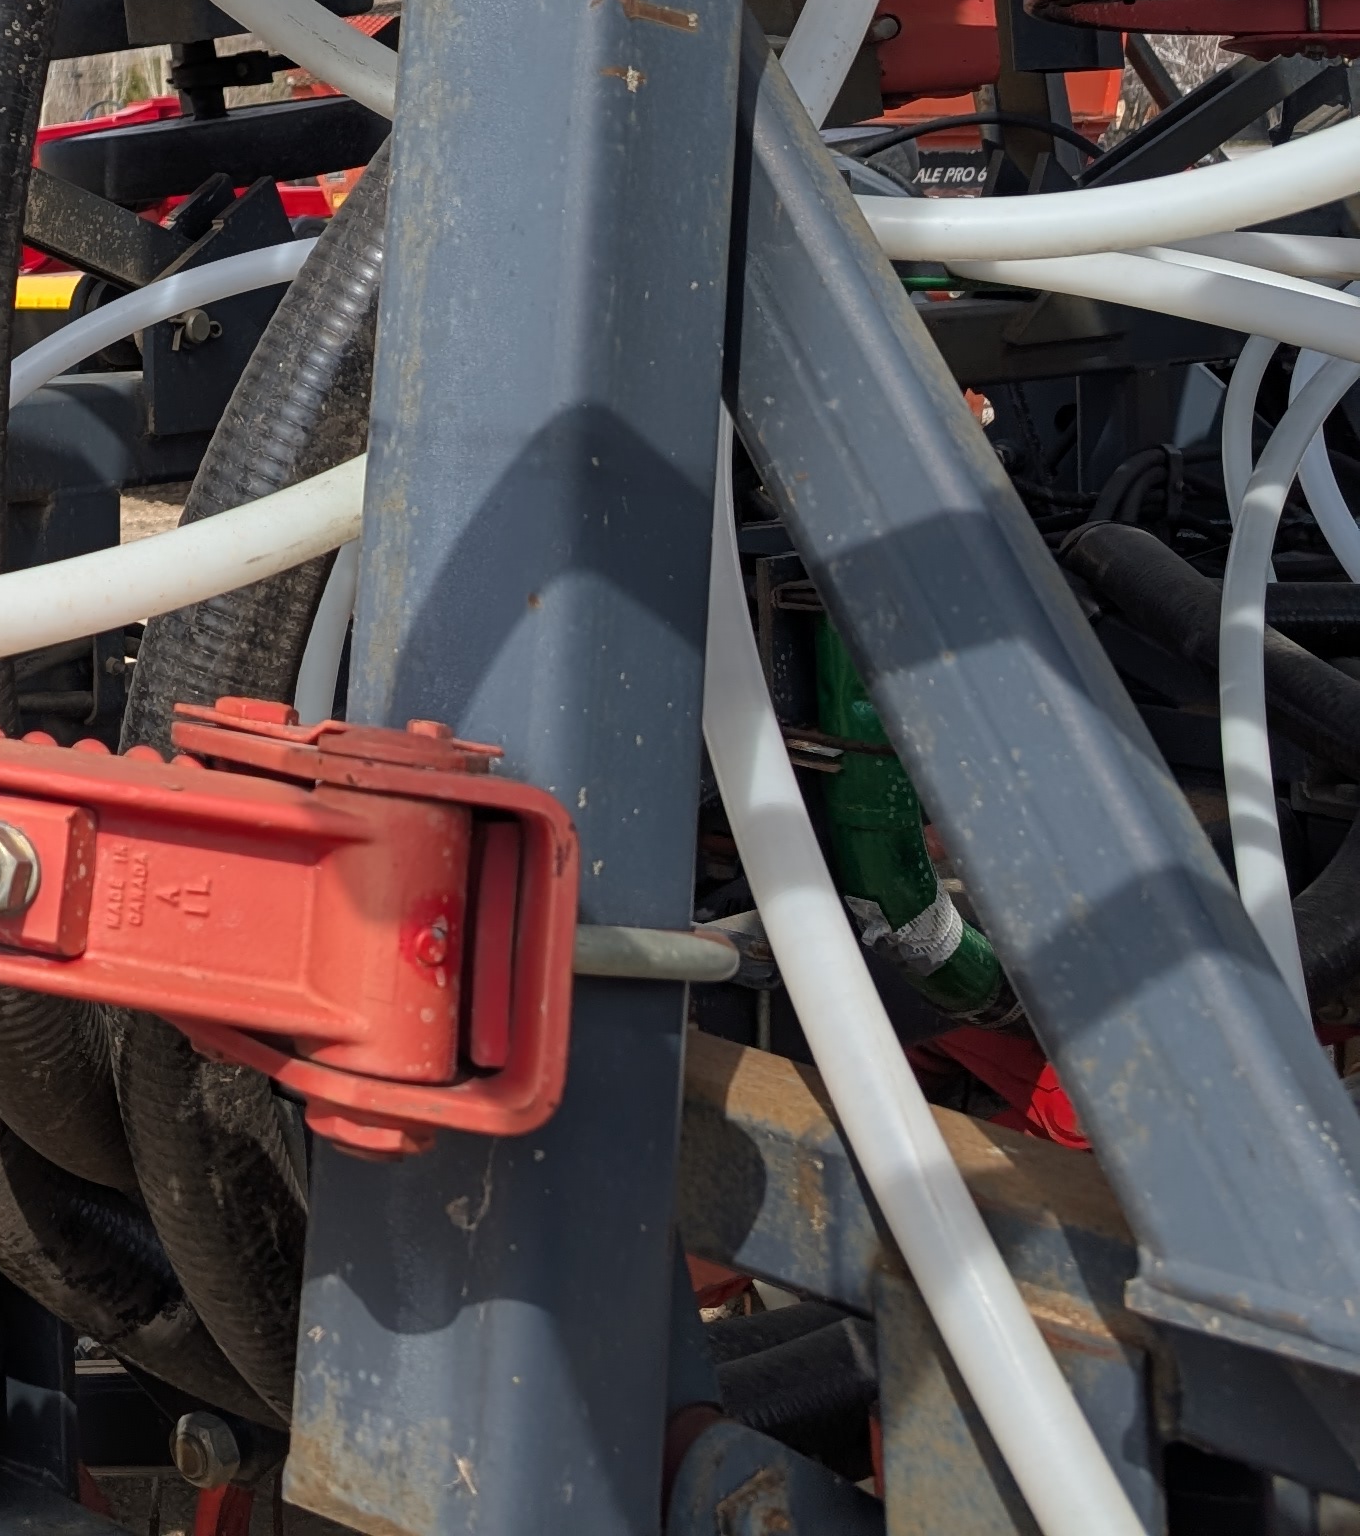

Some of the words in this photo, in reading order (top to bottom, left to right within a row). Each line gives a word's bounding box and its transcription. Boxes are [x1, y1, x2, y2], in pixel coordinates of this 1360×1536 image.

[943, 166, 976, 184] PRO
[105, 877, 126, 931] MADE
[128, 852, 149, 927] CANADA
[155, 886, 182, 909] A
